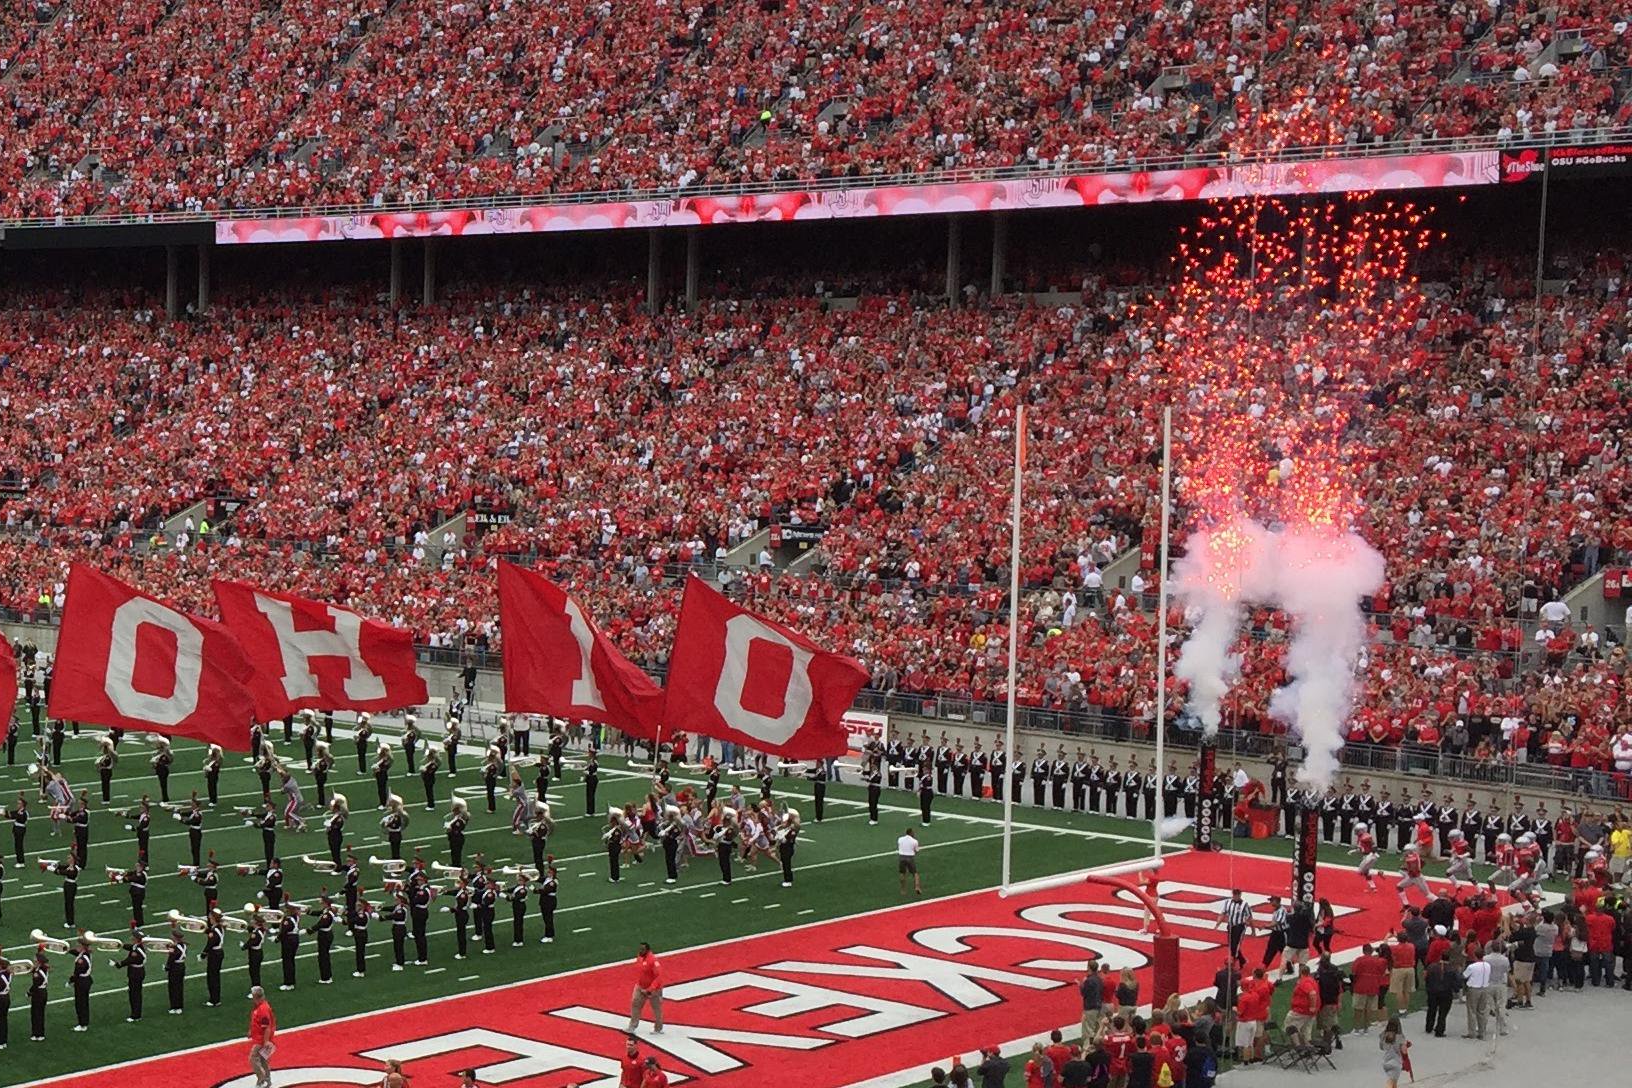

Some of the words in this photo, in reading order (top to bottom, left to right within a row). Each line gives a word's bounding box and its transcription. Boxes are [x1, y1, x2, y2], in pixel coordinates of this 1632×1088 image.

[1551, 157, 1574, 166] OSU
[1575, 155, 1627, 165] #GoBucks
[104, 596, 204, 725] O
[255, 593, 386, 700] H
[713, 614, 815, 746] O
[1118, 1042, 1126, 1059] 1
